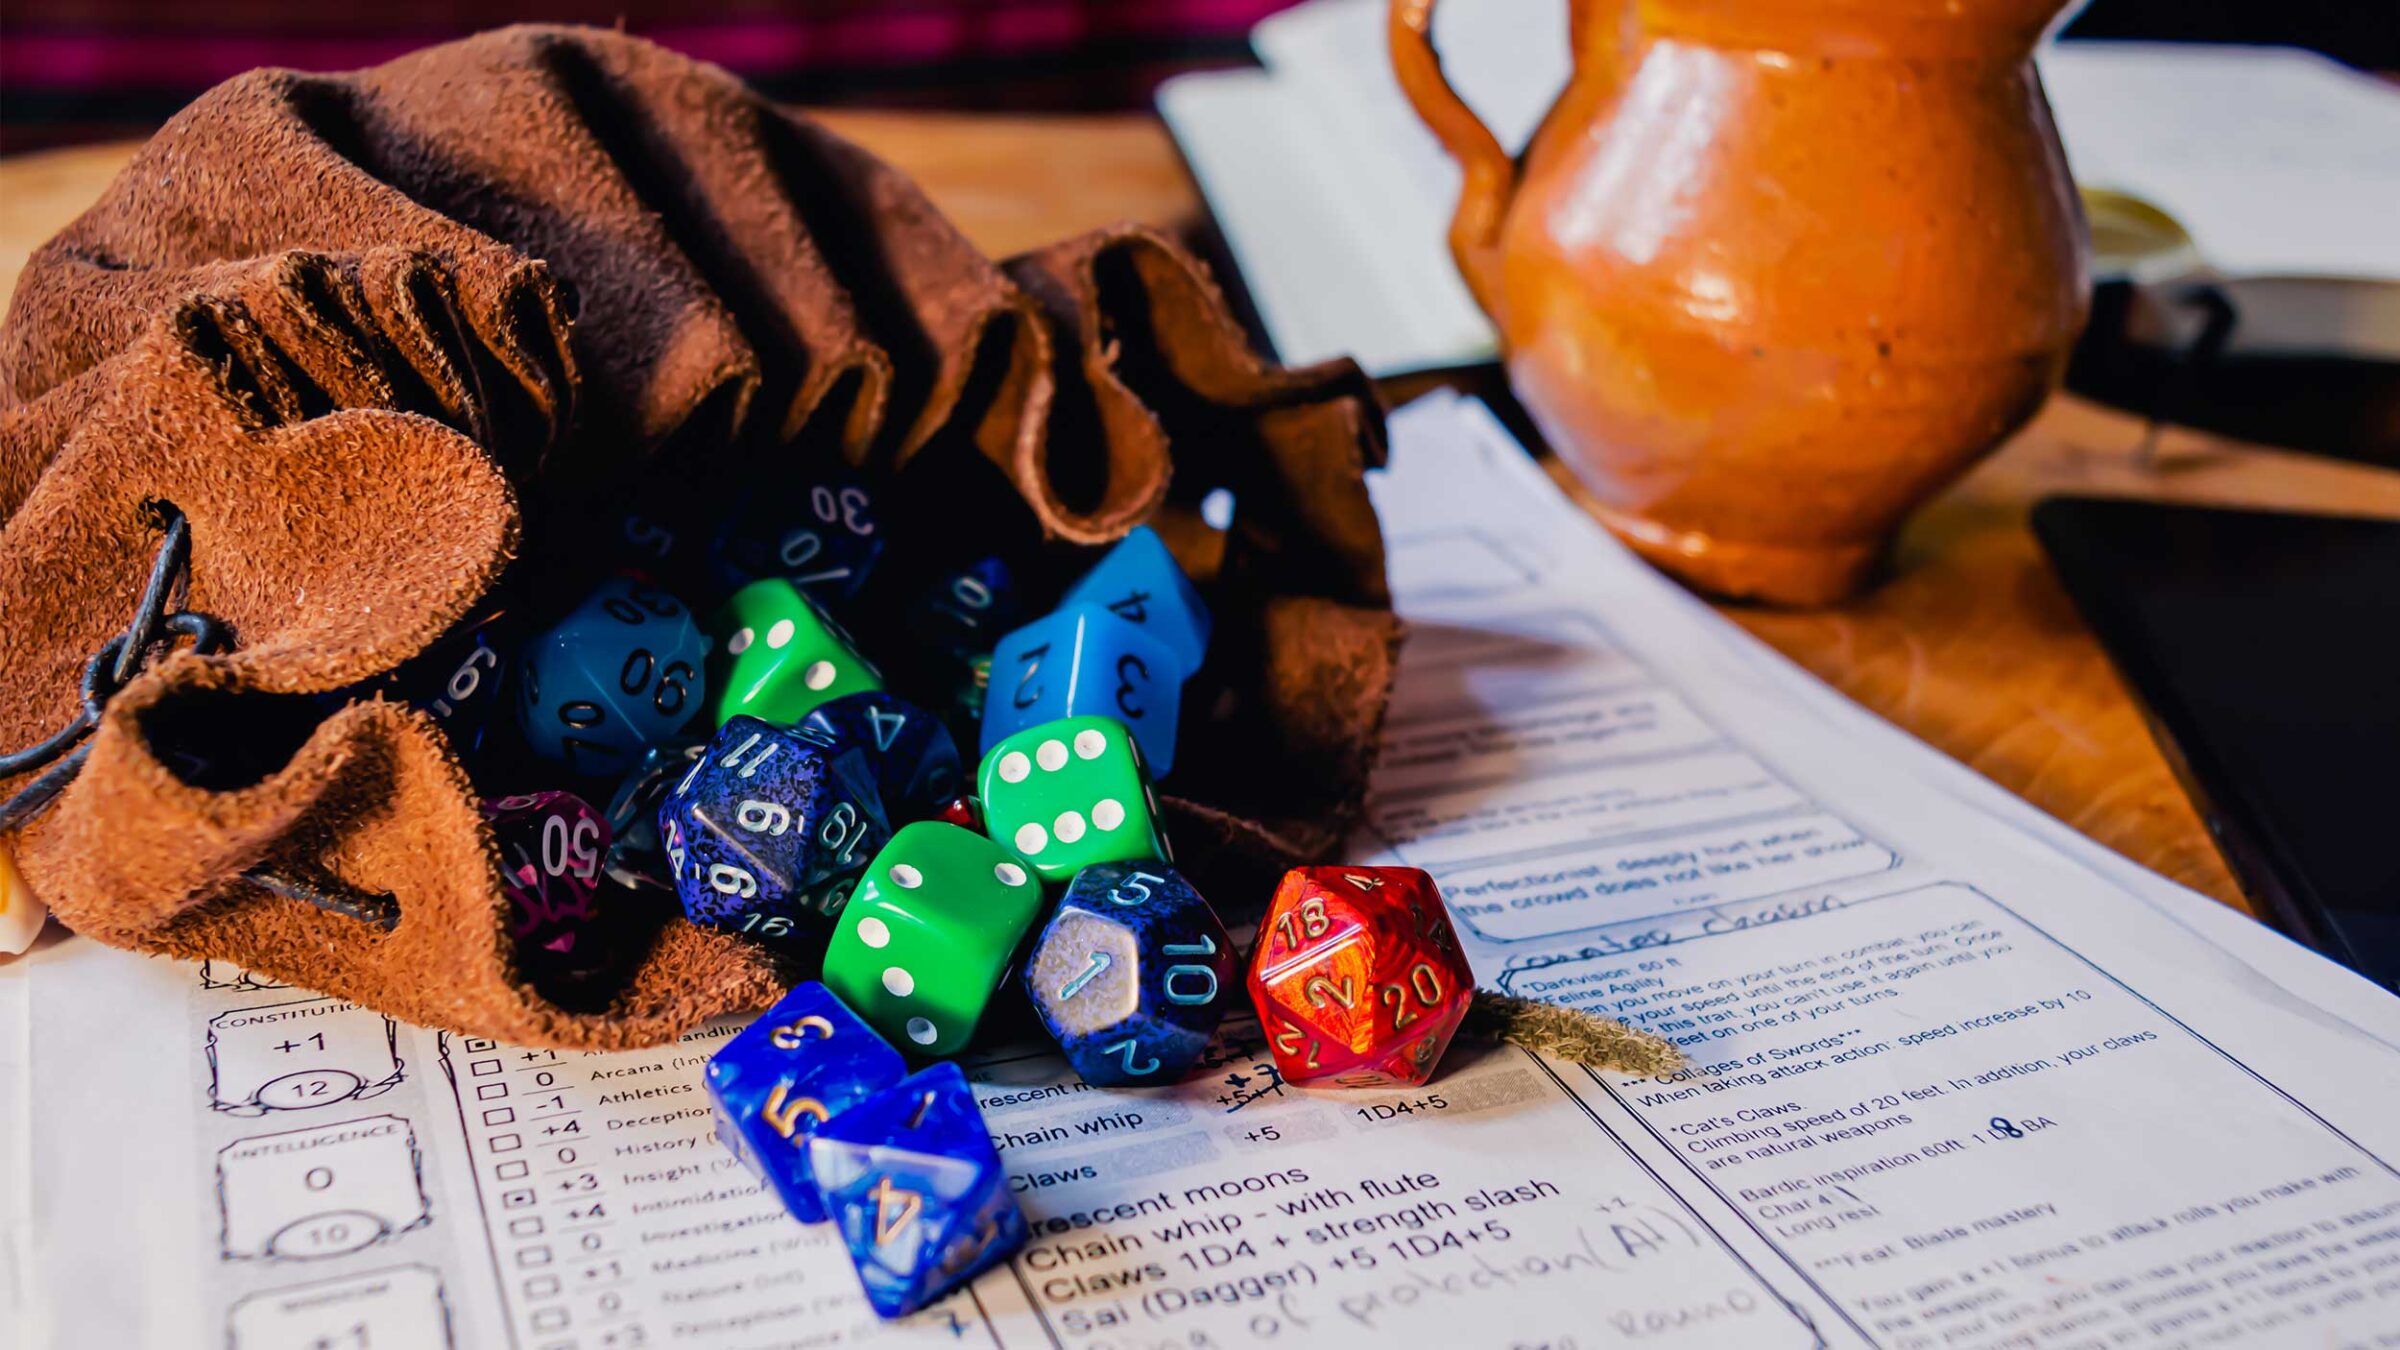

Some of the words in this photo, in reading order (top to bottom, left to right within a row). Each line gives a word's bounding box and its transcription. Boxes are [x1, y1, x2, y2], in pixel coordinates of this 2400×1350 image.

[1107, 590, 1151, 623] 4
[1116, 653, 1148, 719] 3
[864, 705, 906, 752] 4
[720, 733, 779, 778] 11
[542, 814, 600, 879] 50
[1107, 871, 1165, 906] 5
[1344, 874, 1385, 891] 4
[1278, 897, 1330, 950] 18
[1060, 951, 1112, 1001] 1
[1162, 934, 1218, 1006] 10
[1638, 960, 1664, 973] 60
[1306, 975, 1355, 1009] 2
[1384, 963, 1442, 1030] 20
[1609, 976, 1665, 995] Agility
[1614, 996, 1648, 1013] you
[1652, 984, 1704, 1001] move
[1708, 977, 1732, 990] on
[1736, 965, 1776, 987] your
[1634, 1004, 1677, 1027] your
[1681, 992, 1740, 1014] speed
[1743, 981, 1783, 999] until
[1784, 973, 1817, 989] the
[1819, 965, 1856, 980] end
[1858, 958, 1876, 972] of
[1659, 1018, 1696, 1033] this
[1748, 1001, 1781, 1017] you
[1784, 987, 1829, 1005] can't
[1831, 977, 1867, 994] use
[1885, 960, 1936, 980] again
[216, 1003, 363, 1029] CONSTITUTIO
[769, 1015, 835, 1049] 3
[1712, 1026, 1738, 1039] on
[1741, 1018, 1779, 1033] one
[1782, 1010, 1802, 1024] of
[1803, 998, 1846, 1021] your
[273, 1032, 325, 1053] +1
[677, 1025, 751, 1043] andlin
[1636, 1086, 1702, 1109] When
[1703, 1069, 1767, 1096] taking
[1767, 1059, 1829, 1081] attack
[1829, 1041, 1894, 1065] action:
[1897, 1023, 1958, 1047] speed
[1958, 1003, 2040, 1032] increase
[2038, 998, 2065, 1012] by
[2066, 989, 2092, 1002] 10
[590, 1062, 663, 1081] Arcana
[1103, 1039, 1161, 1076] 2
[1654, 1057, 1744, 1086] Collages
[1746, 1049, 1769, 1067] of
[292, 1080, 328, 1098] 12
[536, 1071, 555, 1087] 0
[599, 1082, 693, 1106] Athletics
[1687, 1126, 1782, 1154] Climbing
[1783, 1108, 1847, 1132] speed
[1849, 1100, 1870, 1117] of
[1871, 1094, 1900, 1111] 20
[1901, 1083, 1949, 1103] feet.
[1948, 1077, 1972, 1091] In
[1974, 1056, 2058, 1086] addition,
[2056, 1043, 2100, 1066] your
[2102, 1028, 2158, 1052] claws
[536, 1095, 565, 1111] -1
[761, 1084, 830, 1139] 5
[978, 1084, 1072, 1110] rescent
[1357, 1093, 1448, 1122] 1D4+5
[1736, 1100, 1807, 1123] Claws.
[541, 1119, 582, 1138] +4
[990, 1126, 1069, 1152] Chain
[1075, 1110, 1143, 1136] whip
[1244, 1125, 1281, 1143] +5
[1705, 1151, 1743, 1171] are
[1748, 1134, 1820, 1160] natural
[1822, 1112, 1913, 1144] weapons
[558, 1147, 577, 1164] 0
[616, 1136, 697, 1157] History
[1738, 1176, 1812, 1203] Bardic
[1814, 1151, 1922, 1188] inspiration
[1971, 1131, 1986, 1145] 1
[2021, 1114, 2058, 1133] BA
[305, 1167, 334, 1191] 0
[560, 1173, 599, 1192] +3
[1007, 1164, 1098, 1194] Claws
[2220, 1195, 2260, 1214] you
[2260, 1177, 2317, 1200] make
[867, 1177, 923, 1246] 4
[1027, 1192, 1176, 1240] rescent
[1184, 1167, 1310, 1205] moons
[1757, 1196, 1811, 1221] Char
[1972, 1201, 2058, 1232] mastery
[311, 1224, 351, 1247] 10
[1025, 1234, 1143, 1271] Chain
[1152, 1213, 1242, 1244] whip
[1276, 1189, 1354, 1217] with
[1360, 1172, 1440, 1200] flute
[1775, 1212, 1837, 1239] Long
[1042, 1262, 1167, 1303] Claws
[1179, 1239, 1257, 1270] 1D4
[1271, 1234, 1290, 1248] +
[1305, 1200, 1457, 1245] strength
[1464, 1180, 1560, 1212] slash
[1062, 1302, 1130, 1333] Sai
[1142, 1261, 1317, 1319] (Dagger)
[1331, 1247, 1377, 1270] +5
[1388, 1220, 1511, 1261] 1D4+5
